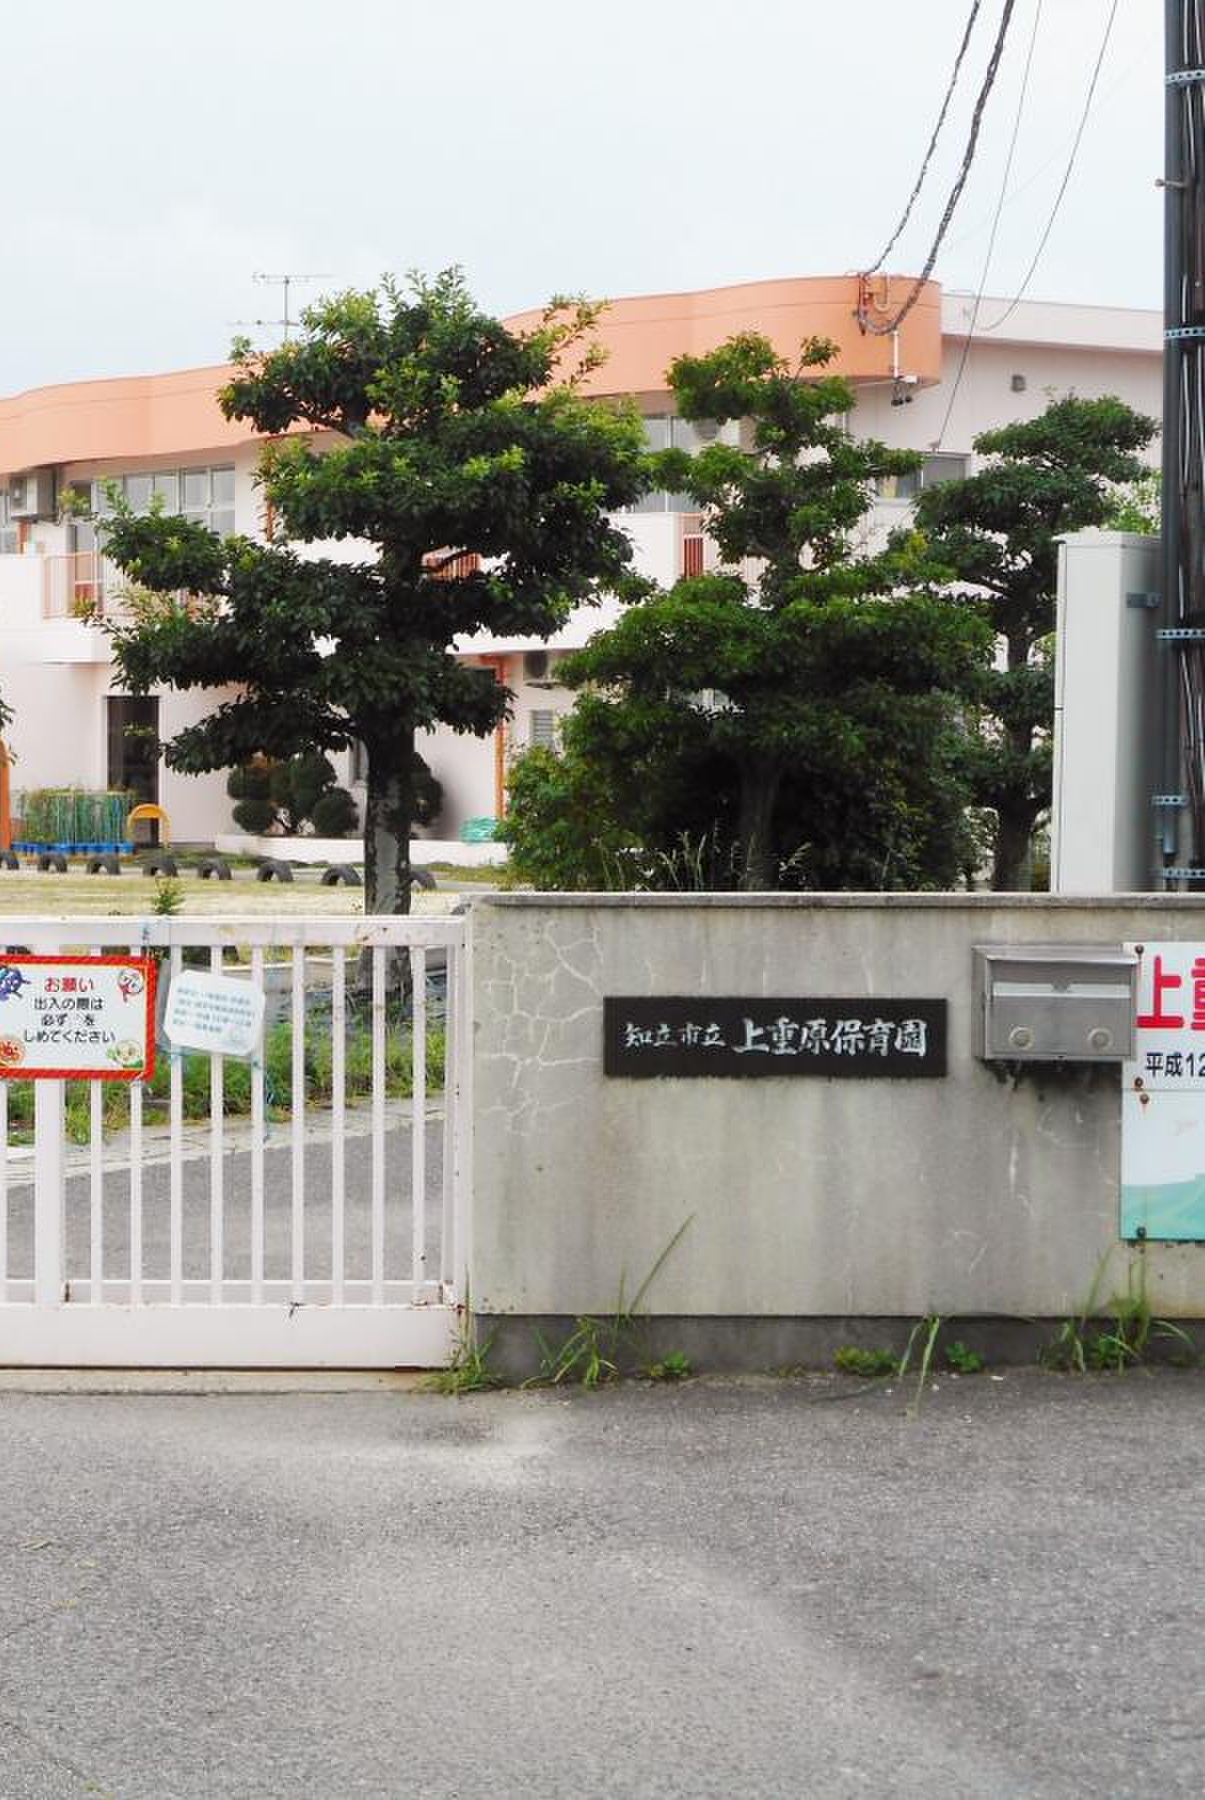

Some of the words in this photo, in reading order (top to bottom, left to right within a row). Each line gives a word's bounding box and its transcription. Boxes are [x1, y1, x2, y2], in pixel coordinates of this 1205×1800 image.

[44, 977, 94, 993] お願い
[24, 1030, 116, 1043] しめてください
[733, 1016, 928, 1057] 上重原保育園
